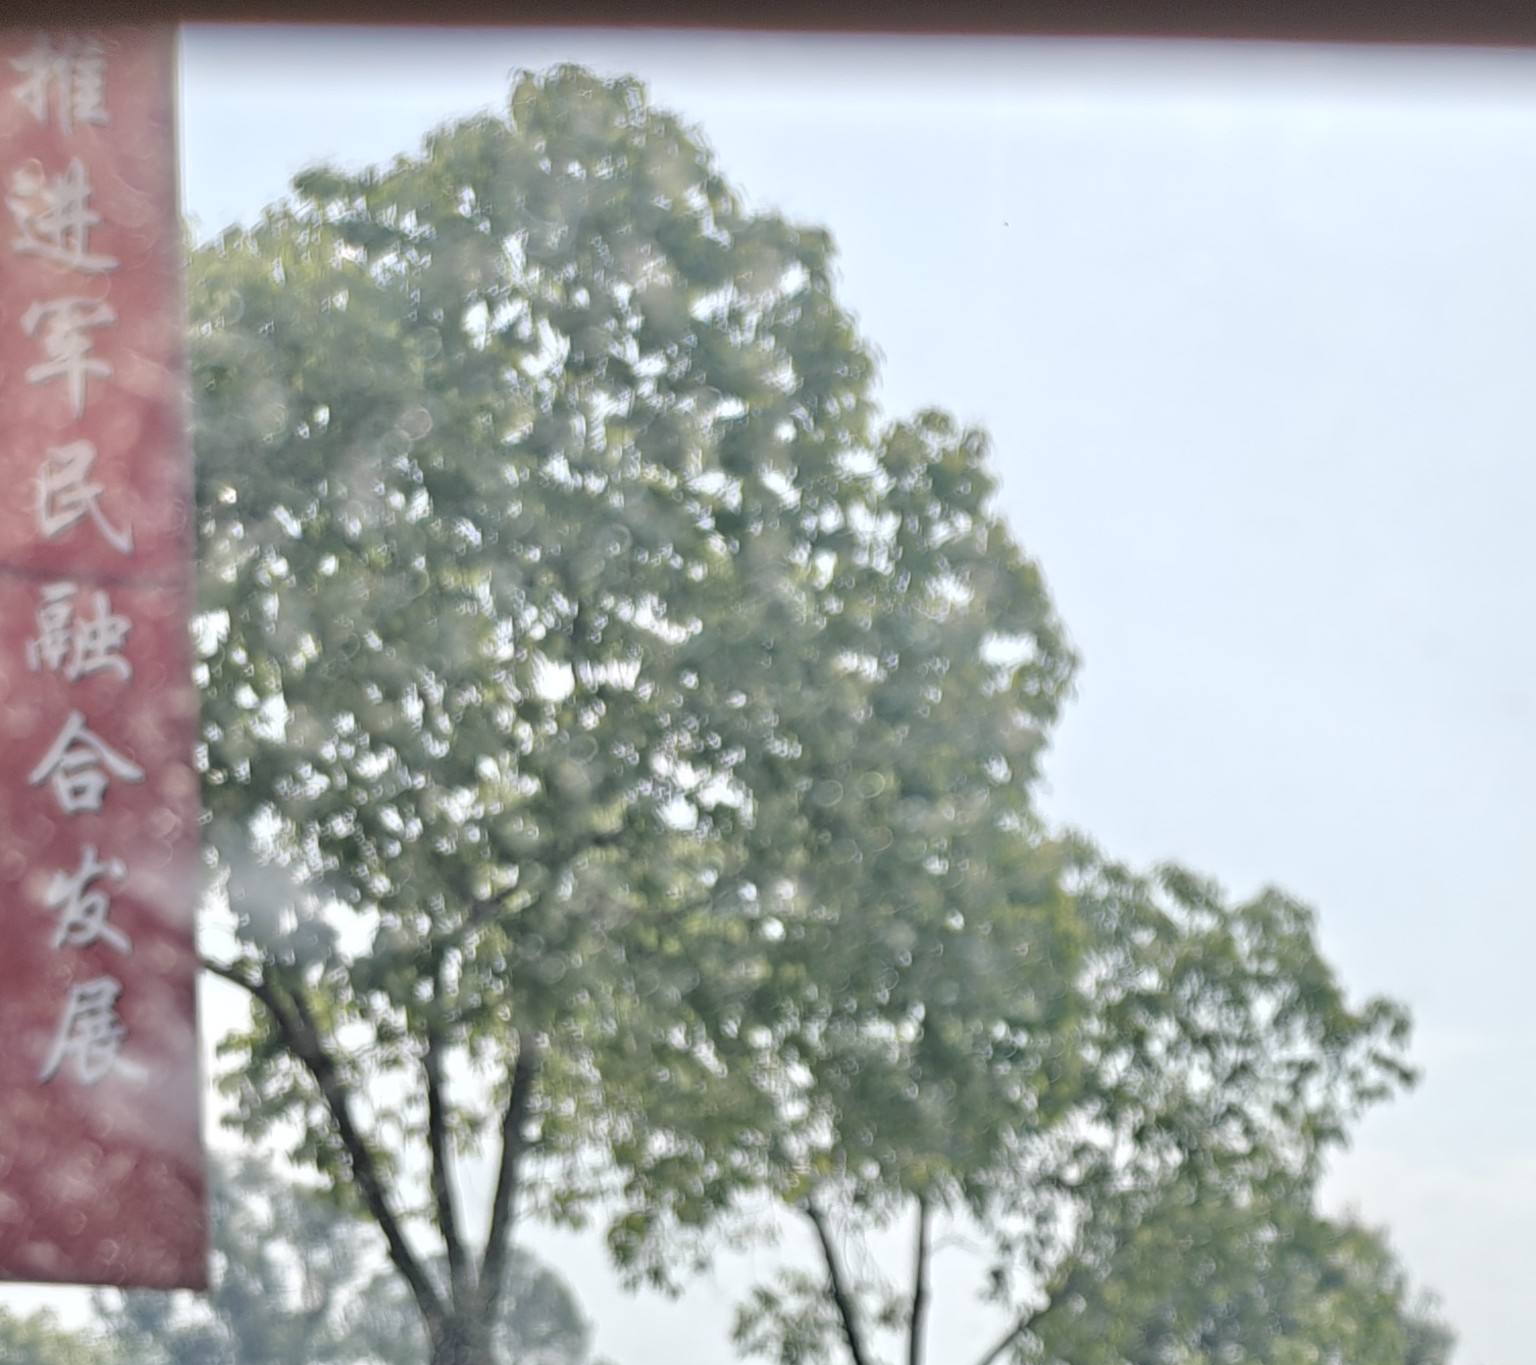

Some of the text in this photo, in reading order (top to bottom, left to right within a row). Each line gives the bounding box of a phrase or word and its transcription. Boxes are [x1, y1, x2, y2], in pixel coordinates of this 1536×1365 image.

[6, 34, 150, 1086] 推进军民融合发展
